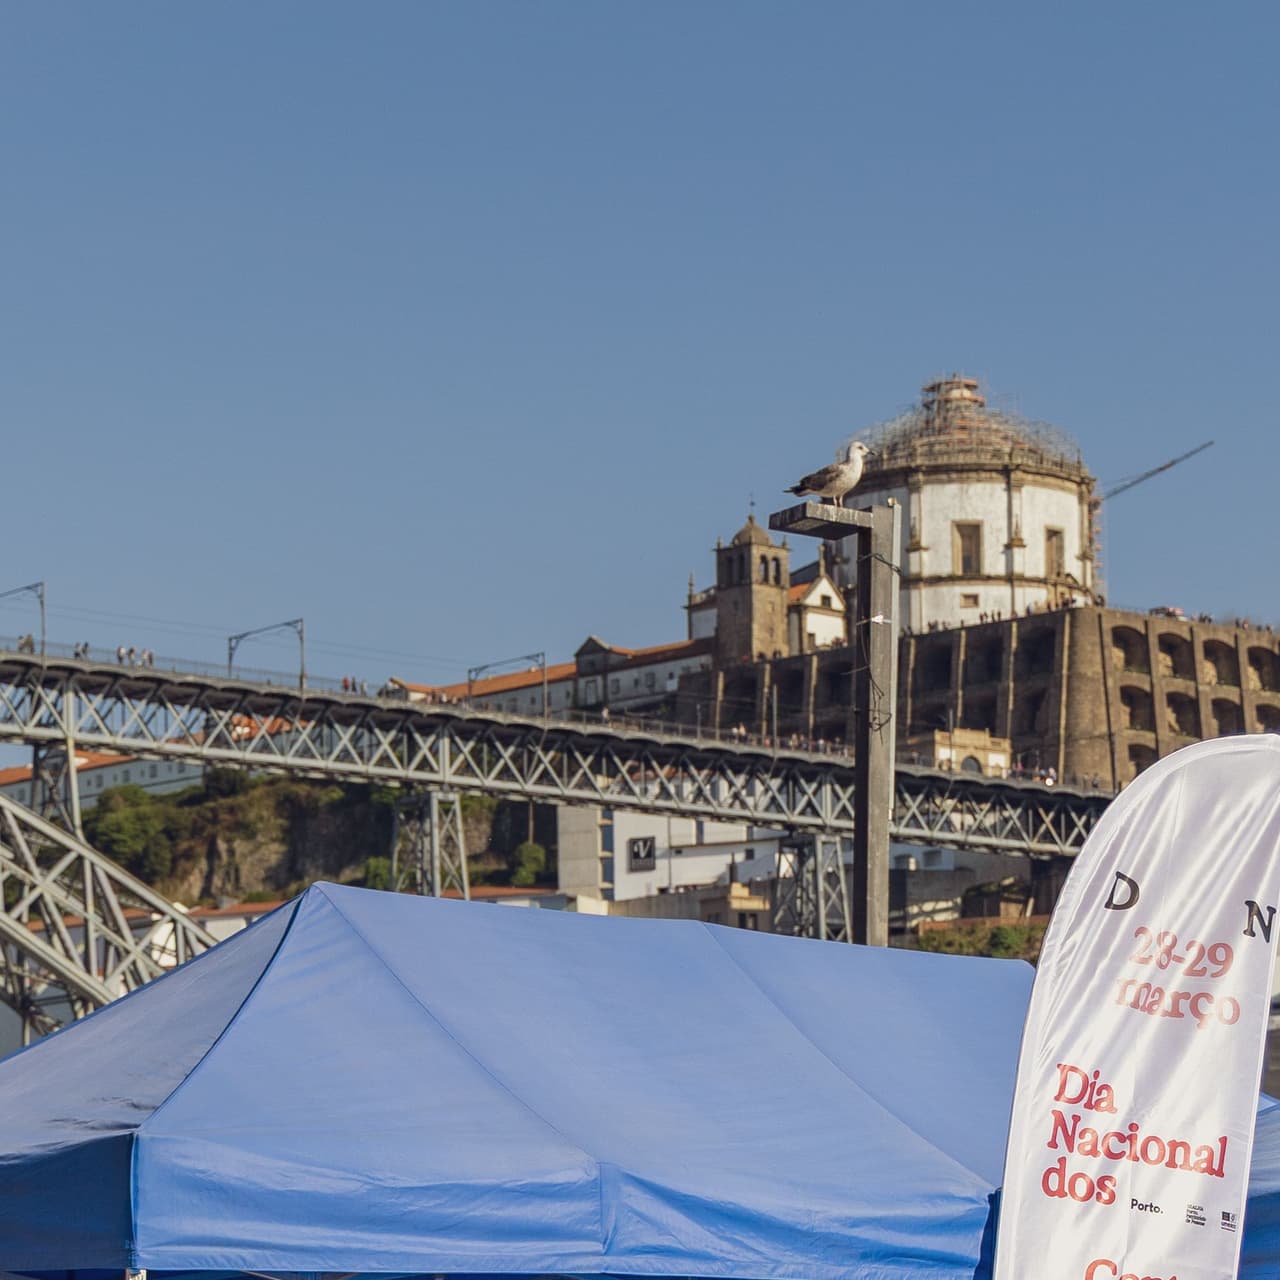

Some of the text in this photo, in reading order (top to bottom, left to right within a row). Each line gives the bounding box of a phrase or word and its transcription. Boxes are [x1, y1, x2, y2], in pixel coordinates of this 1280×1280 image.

[1104, 871, 1277, 944] D N
[1128, 925, 1235, 979] 28-29
[1114, 977, 1241, 1030] março
[1053, 1062, 1119, 1115] Dia
[1047, 1109, 1228, 1178] Nacional
[1041, 1155, 1117, 1206] dos
[1130, 1198, 1164, 1214] Porto.
